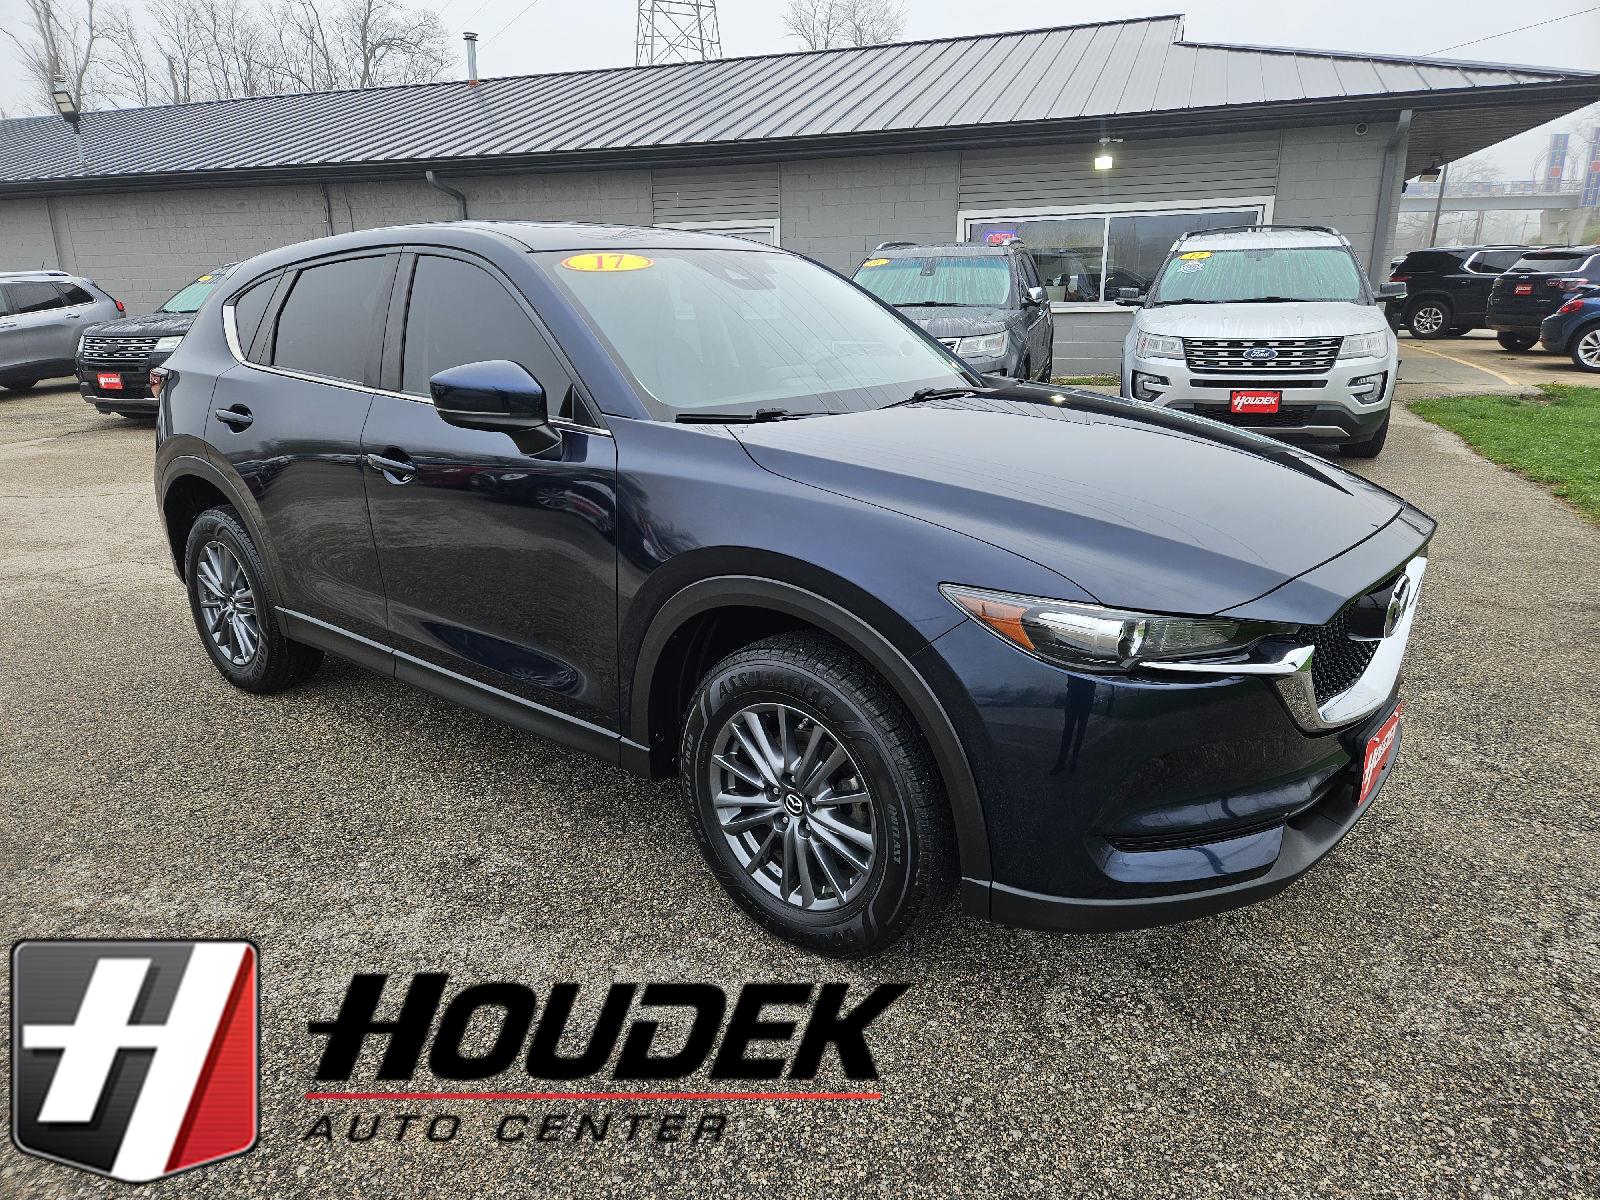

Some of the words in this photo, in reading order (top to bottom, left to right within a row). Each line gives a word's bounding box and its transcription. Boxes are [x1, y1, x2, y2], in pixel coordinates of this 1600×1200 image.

[592, 255, 625, 270] 17
[1250, 349, 1270, 358] Ford
[1233, 395, 1279, 411] HOUDEK
